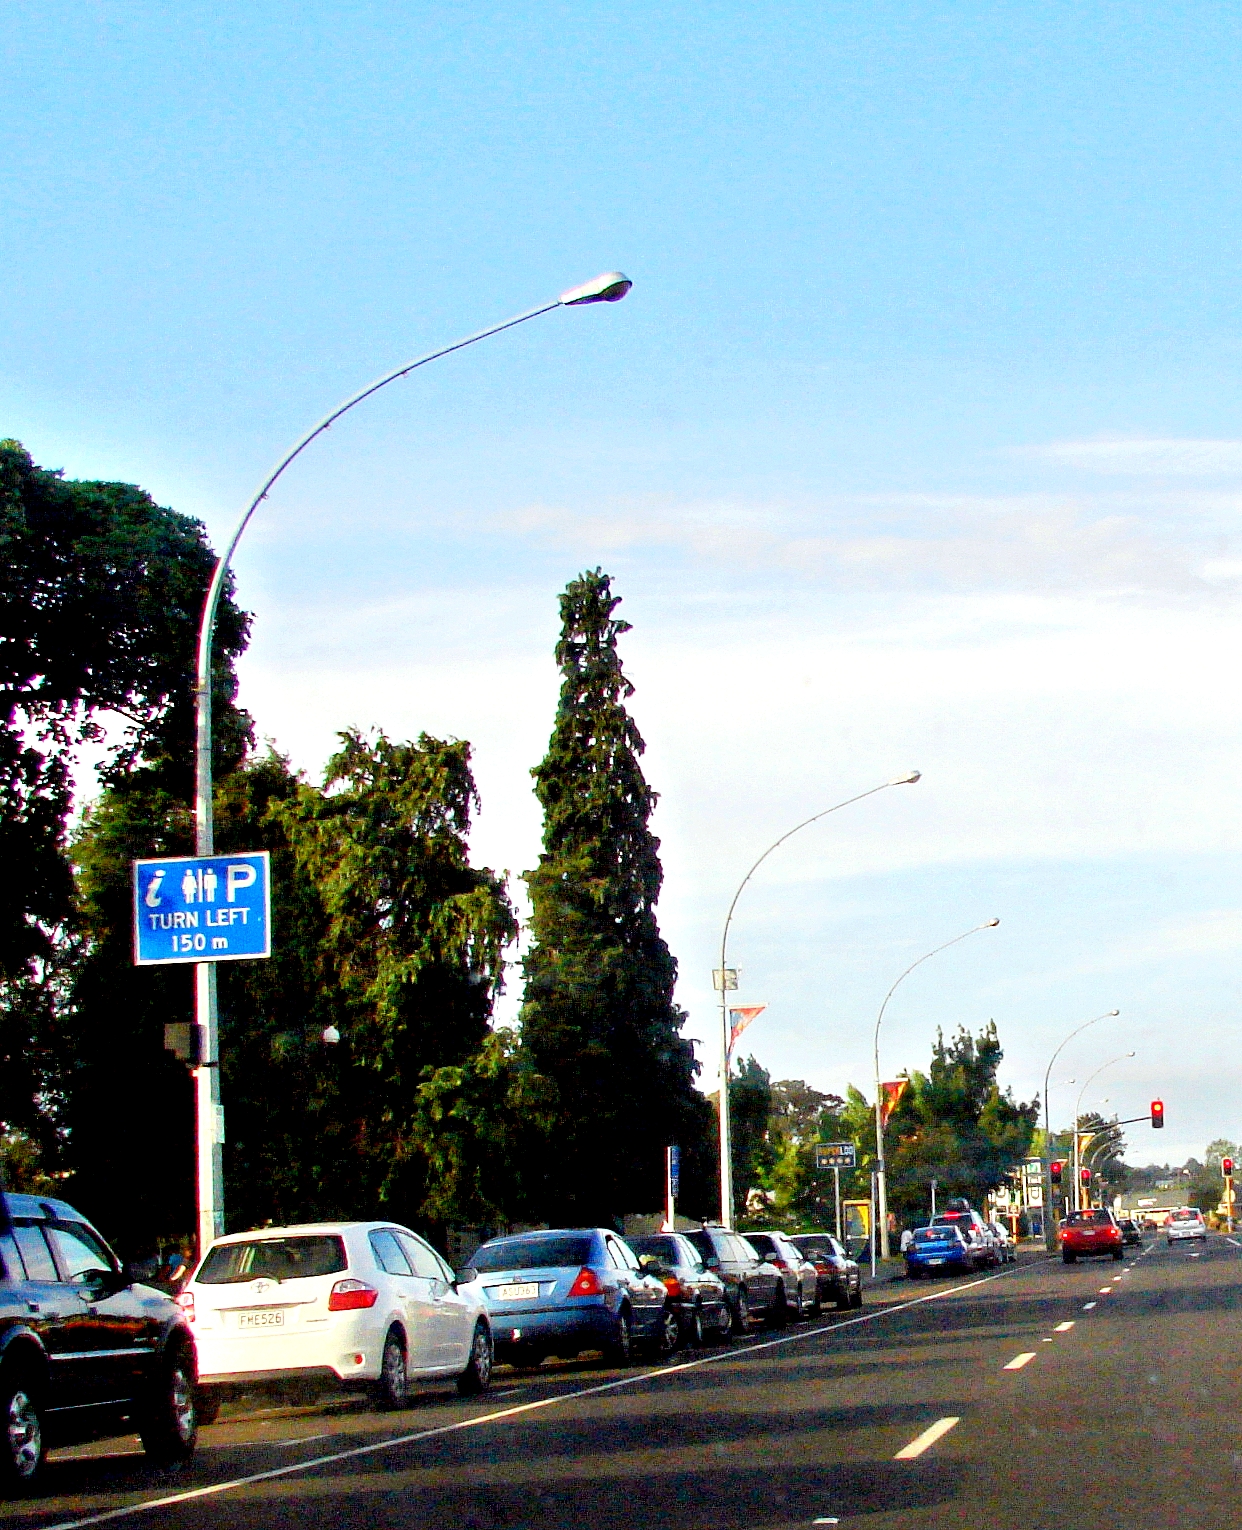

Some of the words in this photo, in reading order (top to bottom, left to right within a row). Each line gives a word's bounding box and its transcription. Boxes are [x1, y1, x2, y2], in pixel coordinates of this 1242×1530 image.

[227, 864, 257, 903] P
[149, 911, 199, 931] TURN
[205, 907, 251, 927] LEFT
[172, 933, 206, 952] 150
[211, 936, 229, 950] m
[240, 1312, 282, 1326] FHE526
